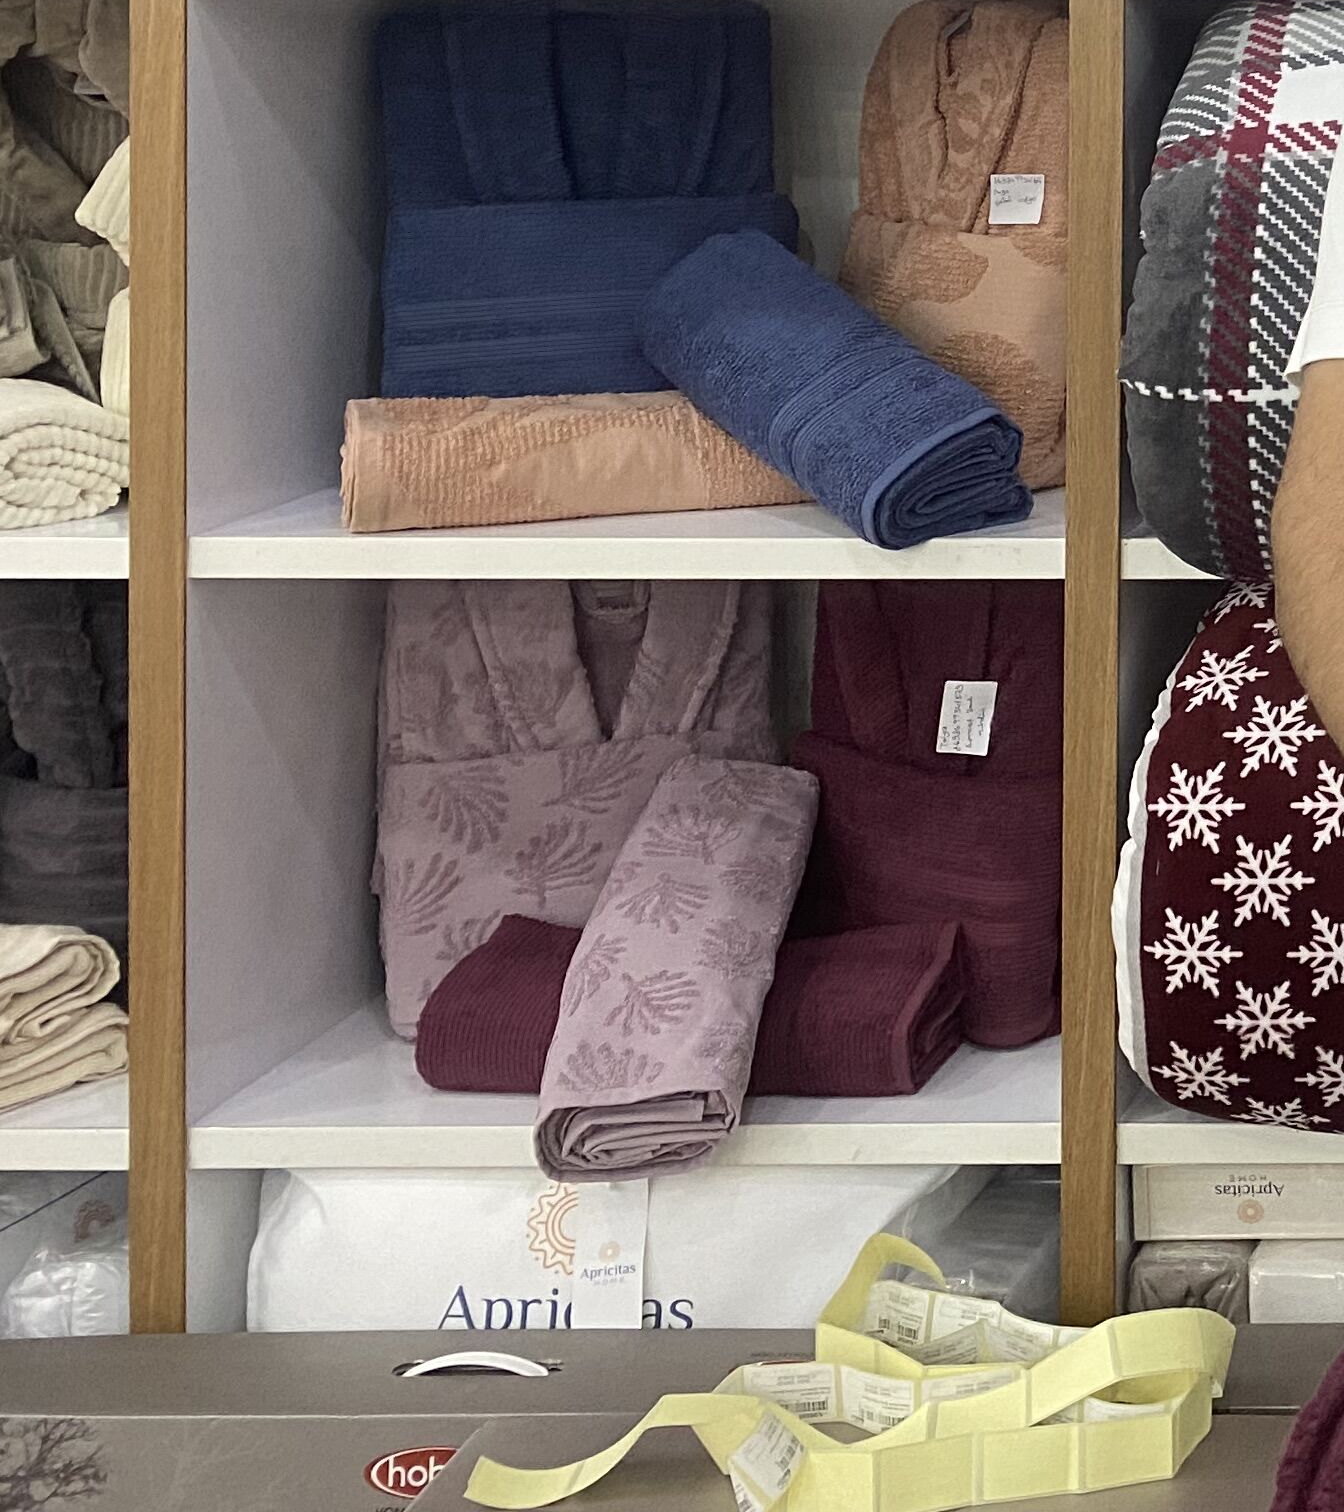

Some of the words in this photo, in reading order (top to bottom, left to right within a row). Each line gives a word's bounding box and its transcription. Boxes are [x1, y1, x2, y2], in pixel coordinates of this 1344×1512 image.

[1214, 1181, 1285, 1197] Apricitas
[579, 1264, 637, 1281] Apricitas
[438, 1285, 695, 1329] Aprias
[387, 1456, 446, 1488] hob
